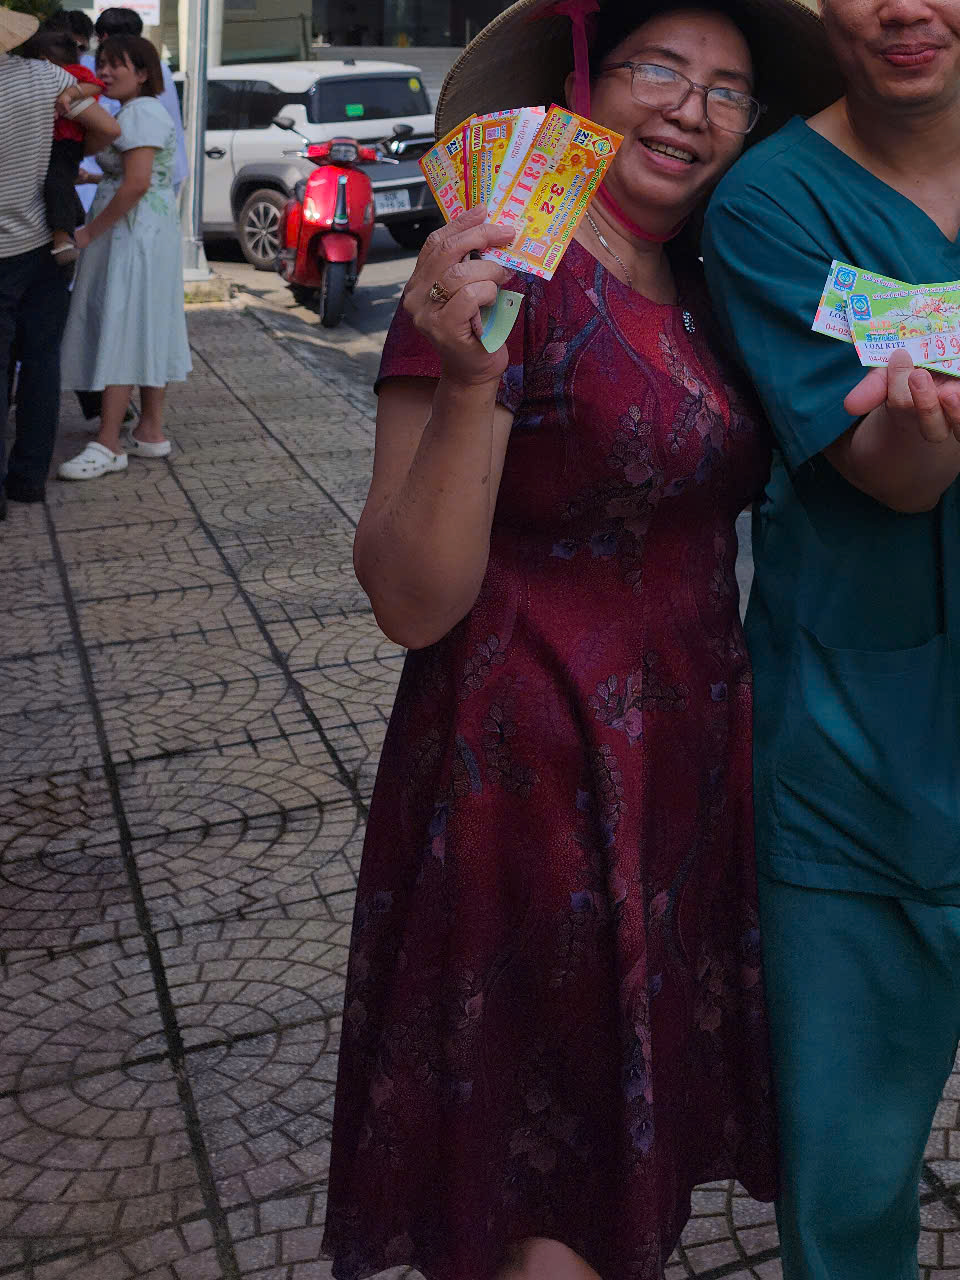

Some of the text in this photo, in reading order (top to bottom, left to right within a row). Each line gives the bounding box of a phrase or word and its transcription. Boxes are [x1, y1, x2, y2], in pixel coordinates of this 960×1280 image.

[536, 112, 558, 147] 04-02-2026
[548, 121, 568, 150] K1T2
[538, 181, 566, 216] 3-2
